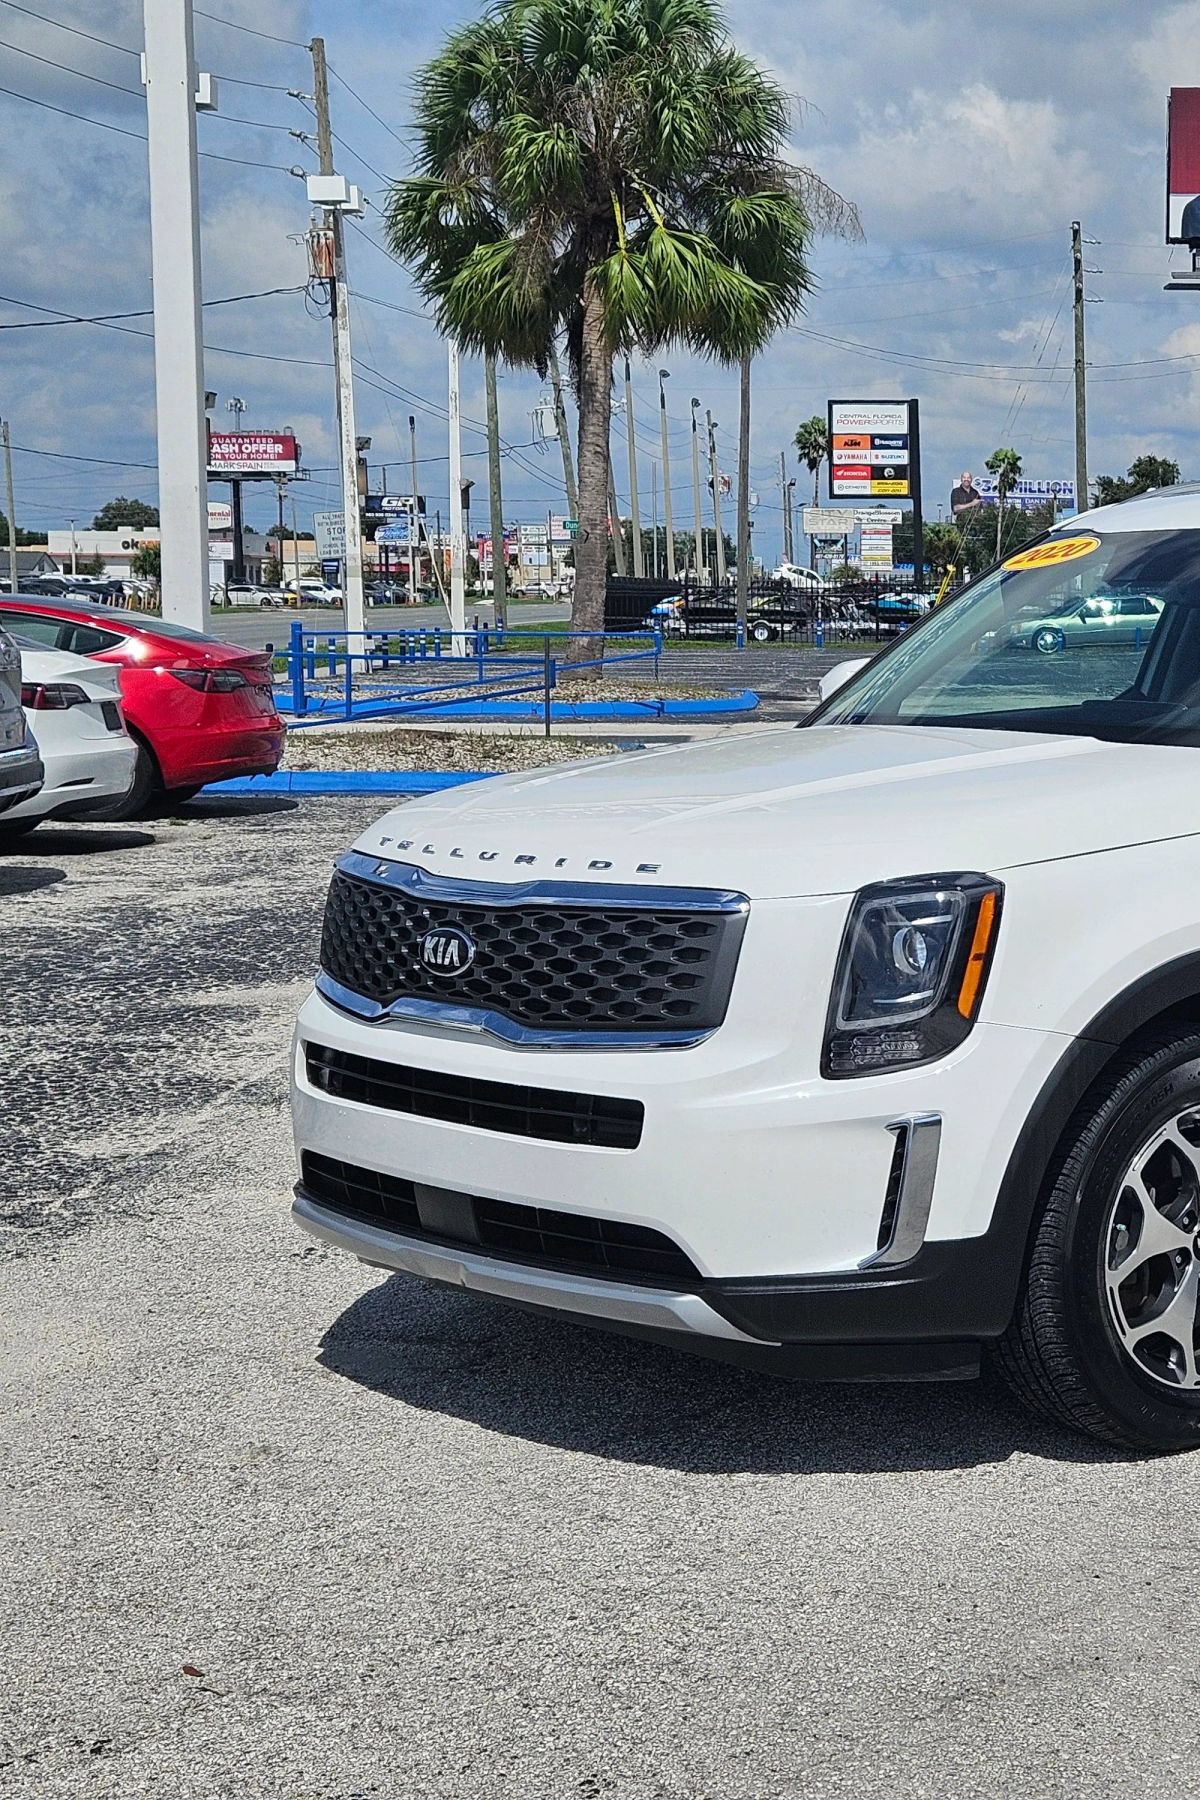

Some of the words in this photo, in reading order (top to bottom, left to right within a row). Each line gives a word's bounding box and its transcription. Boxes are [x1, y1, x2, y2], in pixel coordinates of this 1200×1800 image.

[210, 443, 239, 453] ASH
[241, 443, 284, 454] OFFER
[843, 439, 861, 447] KTM
[1013, 480, 1073, 494] MILLION
[808, 518, 849, 526] STAR
[121, 538, 139, 550] ok
[1007, 541, 1094, 566] 2020
[378, 836, 662, 875] TELLURIDE
[423, 935, 461, 967] KIA
